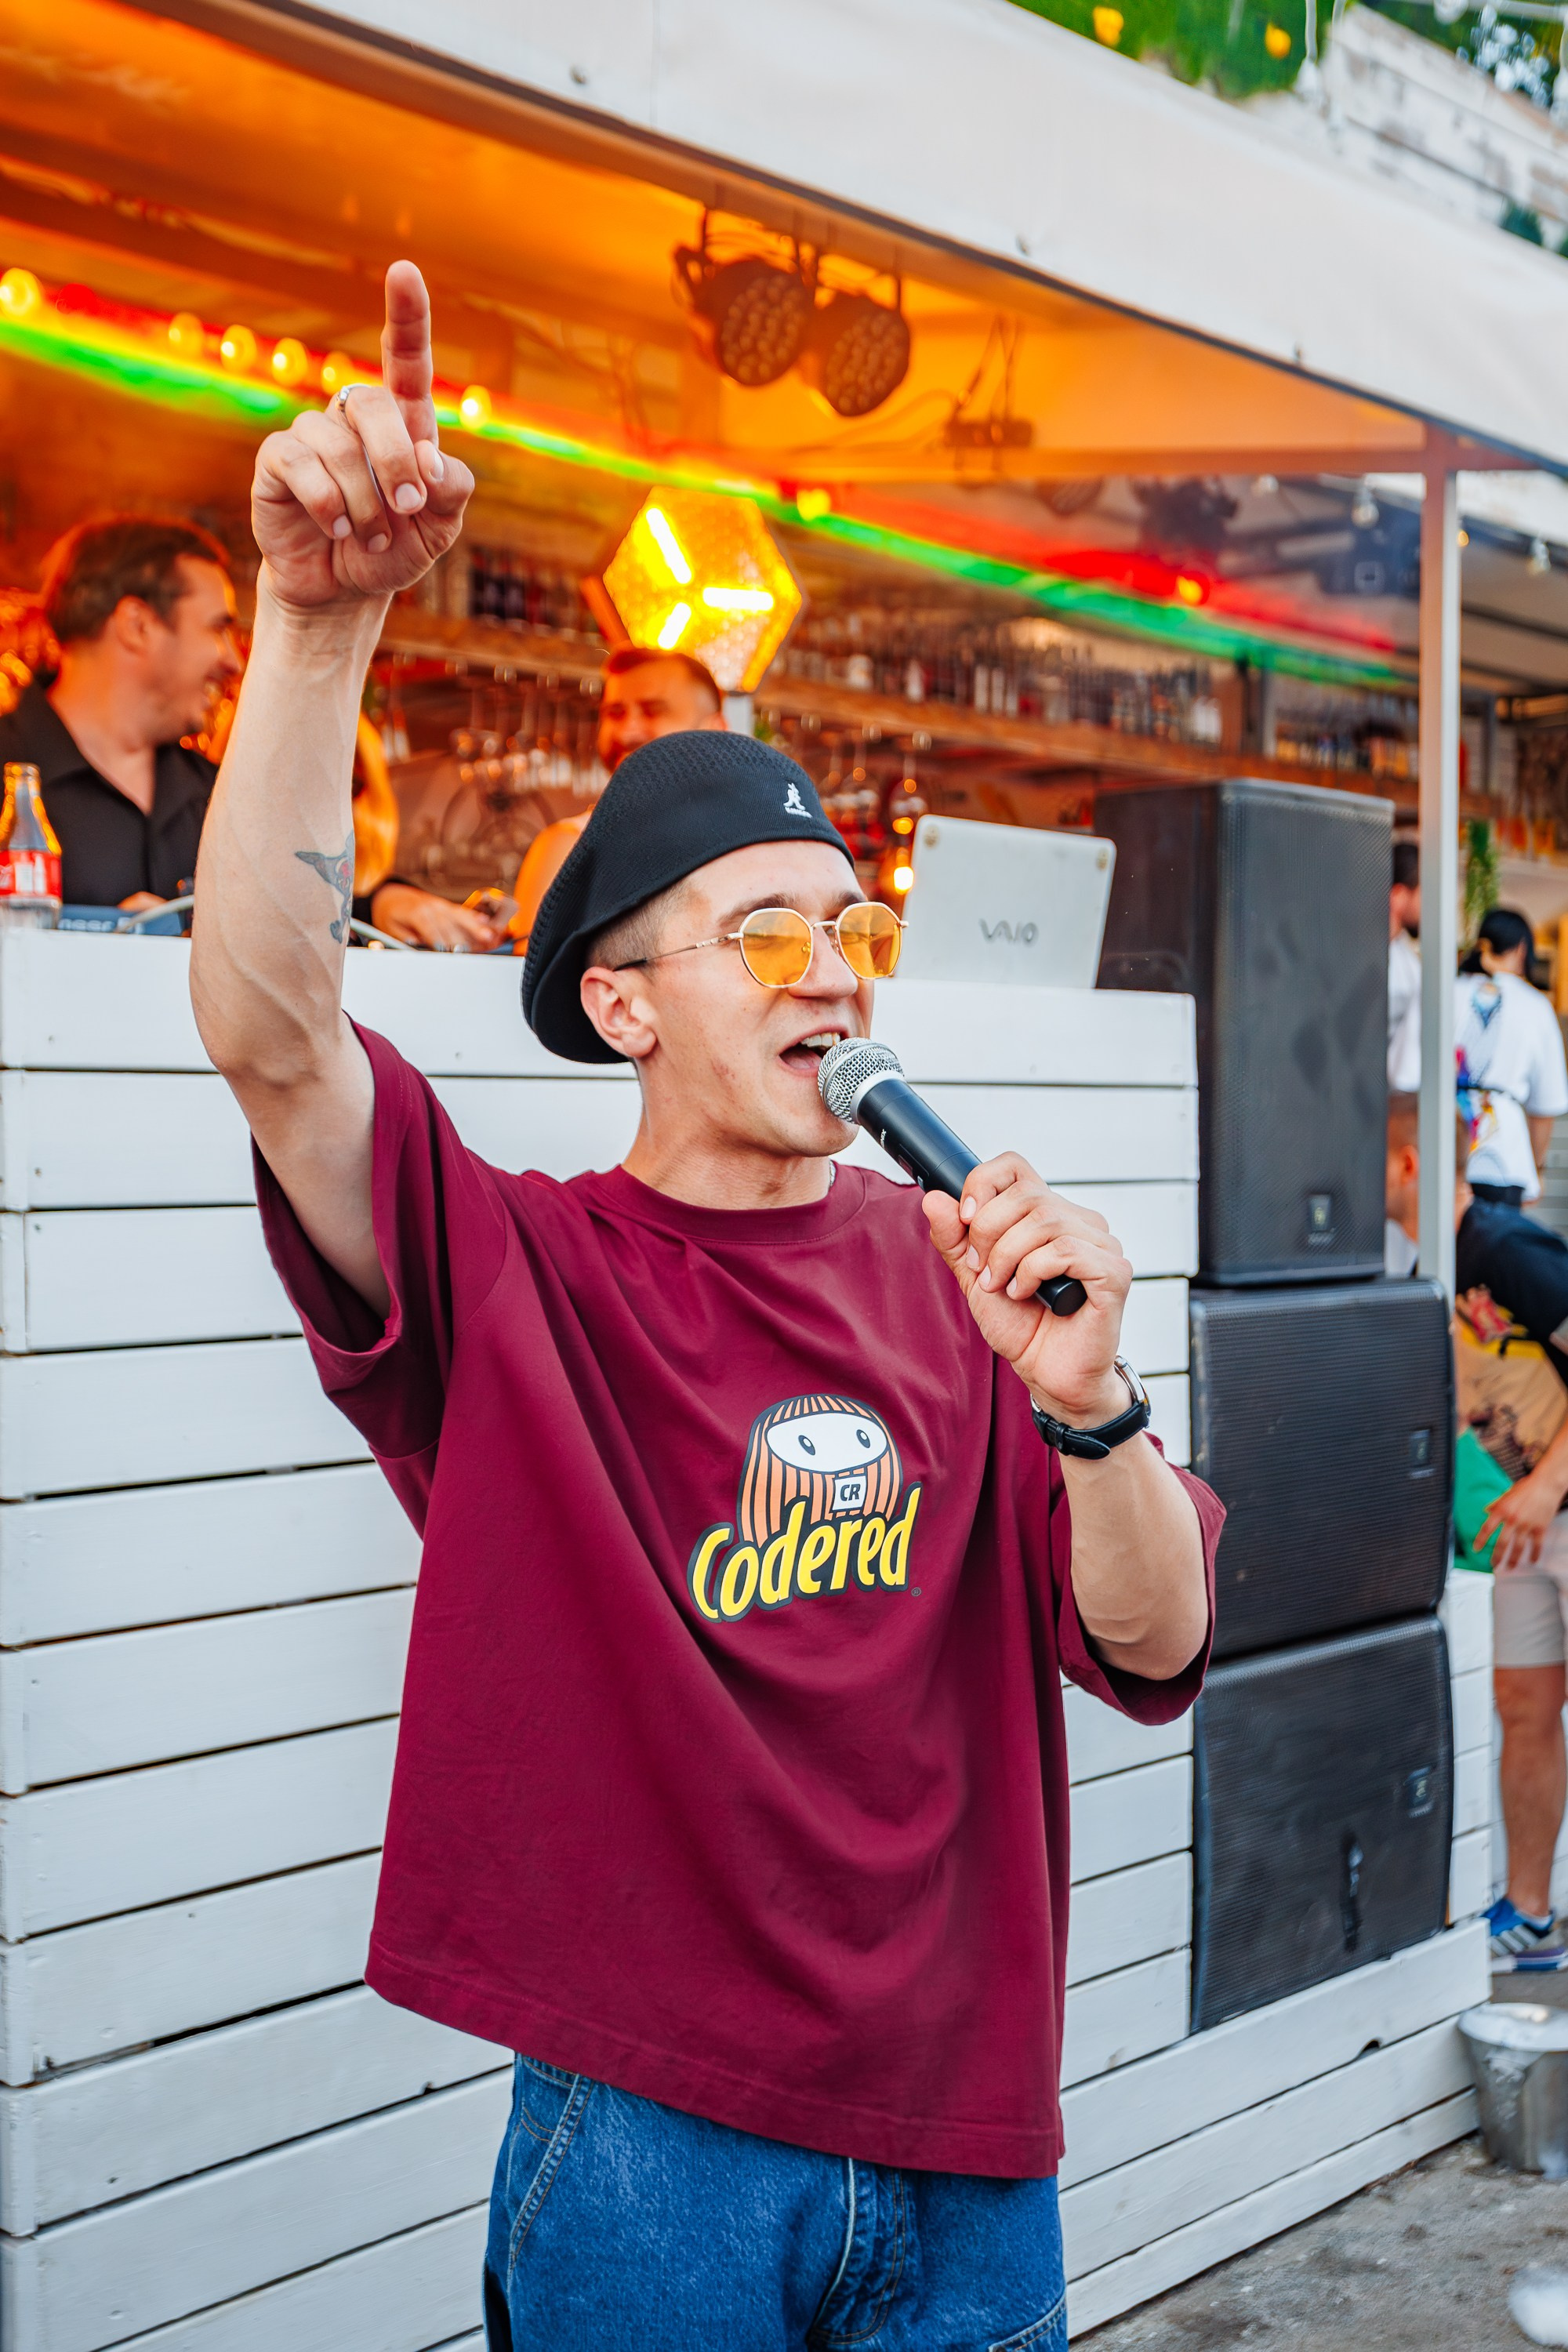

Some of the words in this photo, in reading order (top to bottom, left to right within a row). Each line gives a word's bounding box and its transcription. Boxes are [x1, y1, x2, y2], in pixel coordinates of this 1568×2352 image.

[979, 917, 1040, 947] VAIO
[840, 1483, 861, 1501] CR
[691, 1486, 922, 1621] Codered
